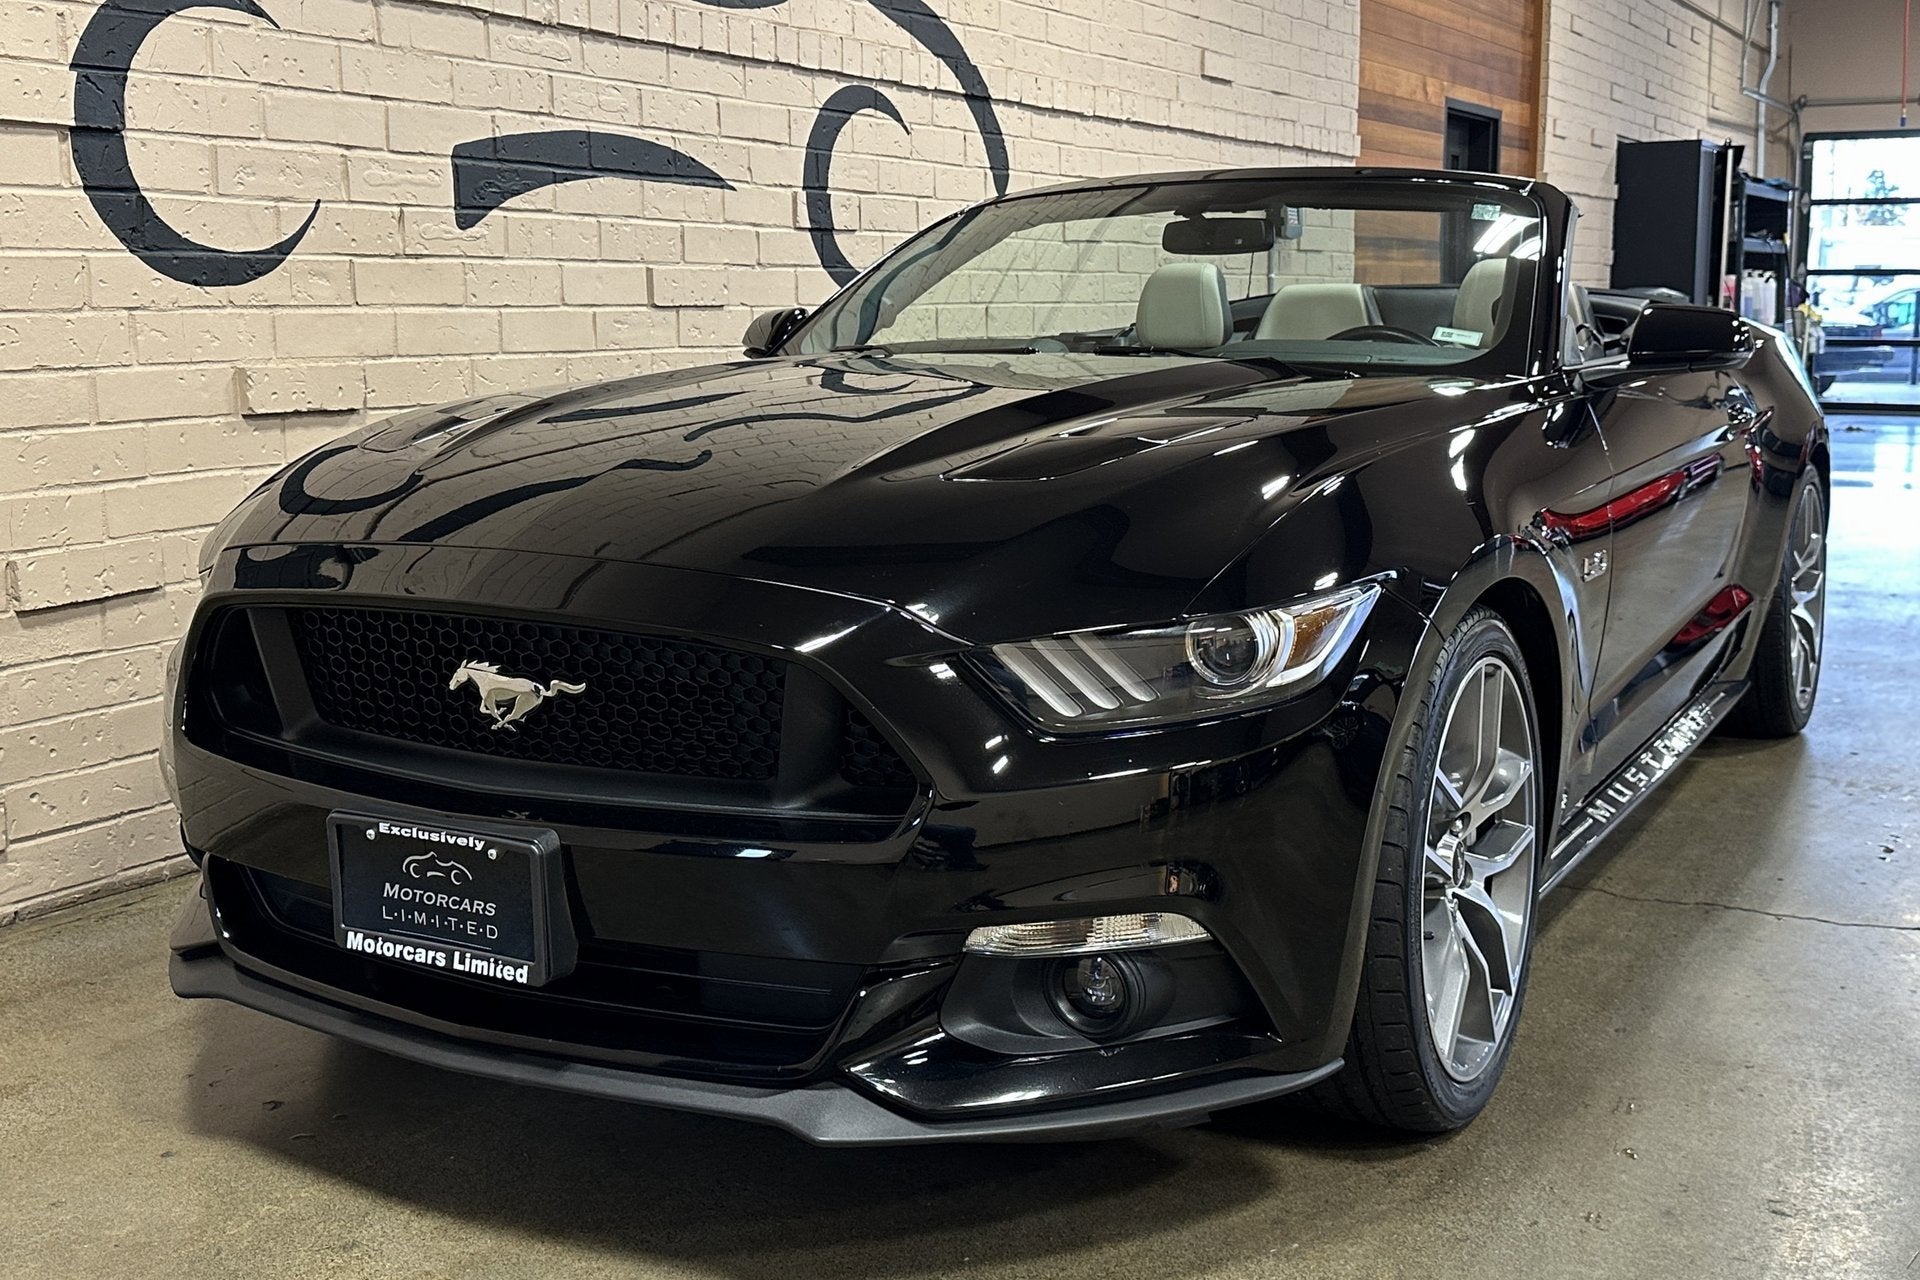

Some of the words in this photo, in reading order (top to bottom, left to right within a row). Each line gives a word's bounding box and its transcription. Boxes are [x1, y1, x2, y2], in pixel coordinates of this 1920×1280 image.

[378, 822, 486, 851] Exclusively
[382, 882, 497, 917] MOTORCARS
[346, 930, 447, 967] Motorcars
[452, 950, 529, 984] Limited
